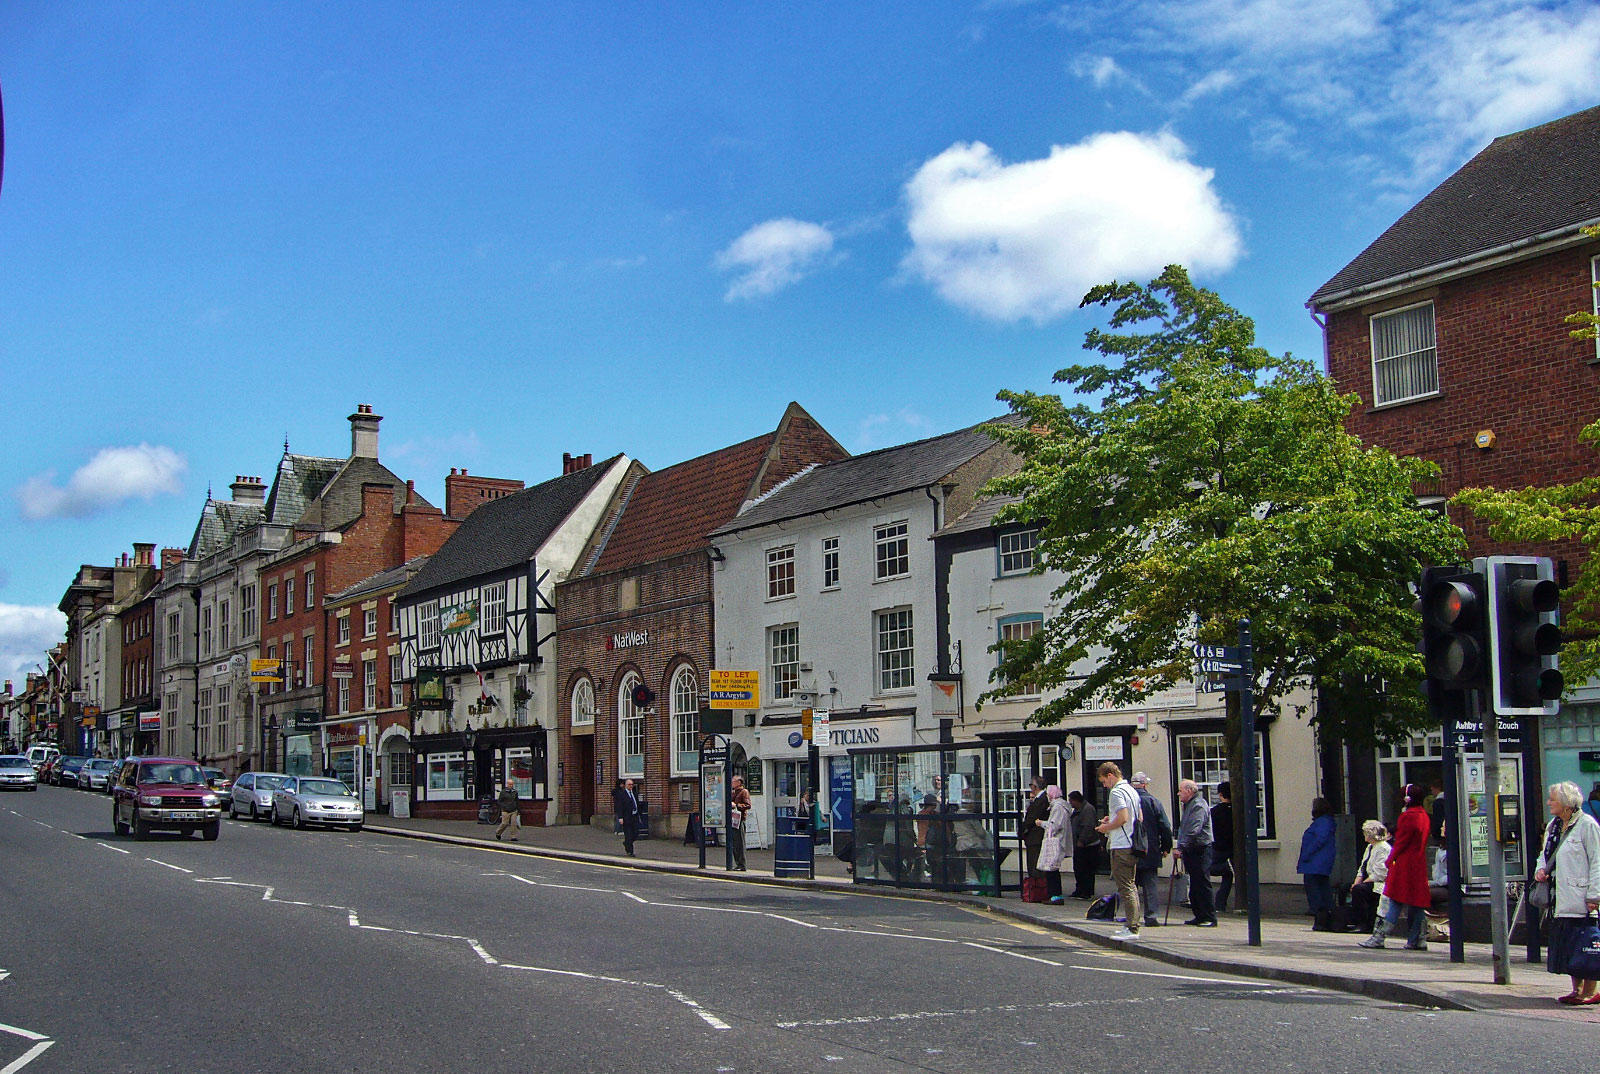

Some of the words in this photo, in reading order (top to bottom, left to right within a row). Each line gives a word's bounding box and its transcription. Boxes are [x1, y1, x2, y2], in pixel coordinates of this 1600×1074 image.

[614, 630, 648, 649] NatWest
[713, 691, 719, 699] A
[719, 691, 725, 699] R
[725, 691, 746, 700] Argyle
[1456, 720, 1477, 731] Ashby
[1498, 721, 1519, 730] Zouch
